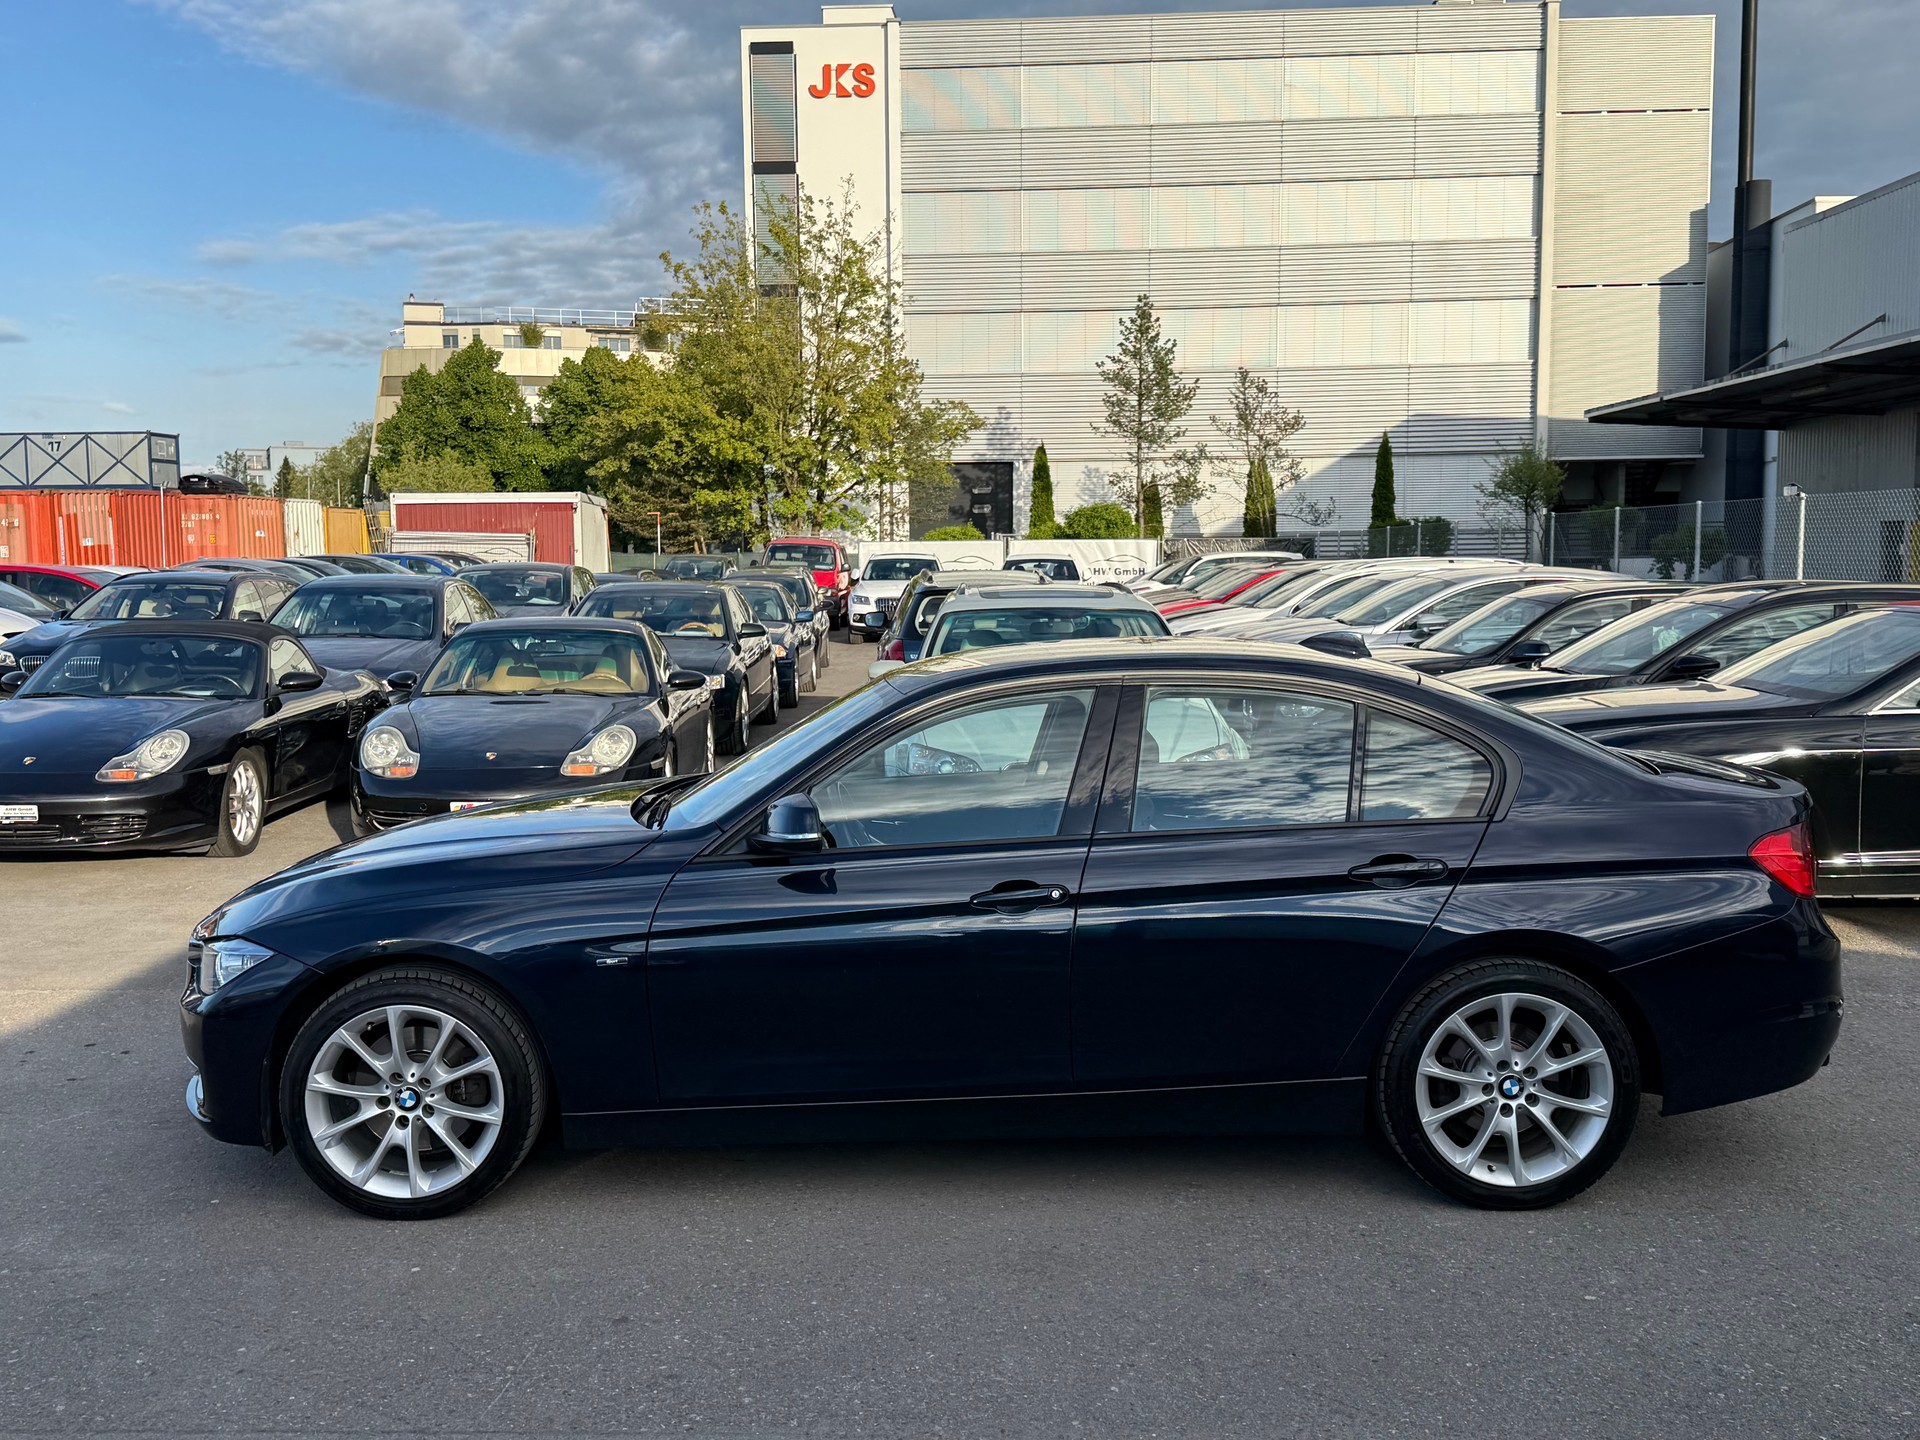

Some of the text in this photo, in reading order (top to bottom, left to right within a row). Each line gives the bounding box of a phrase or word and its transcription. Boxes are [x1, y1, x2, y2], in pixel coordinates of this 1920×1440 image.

[808, 63, 876, 99] JKS
[48, 441, 61, 452] 17
[1114, 567, 1147, 576] GmbH
